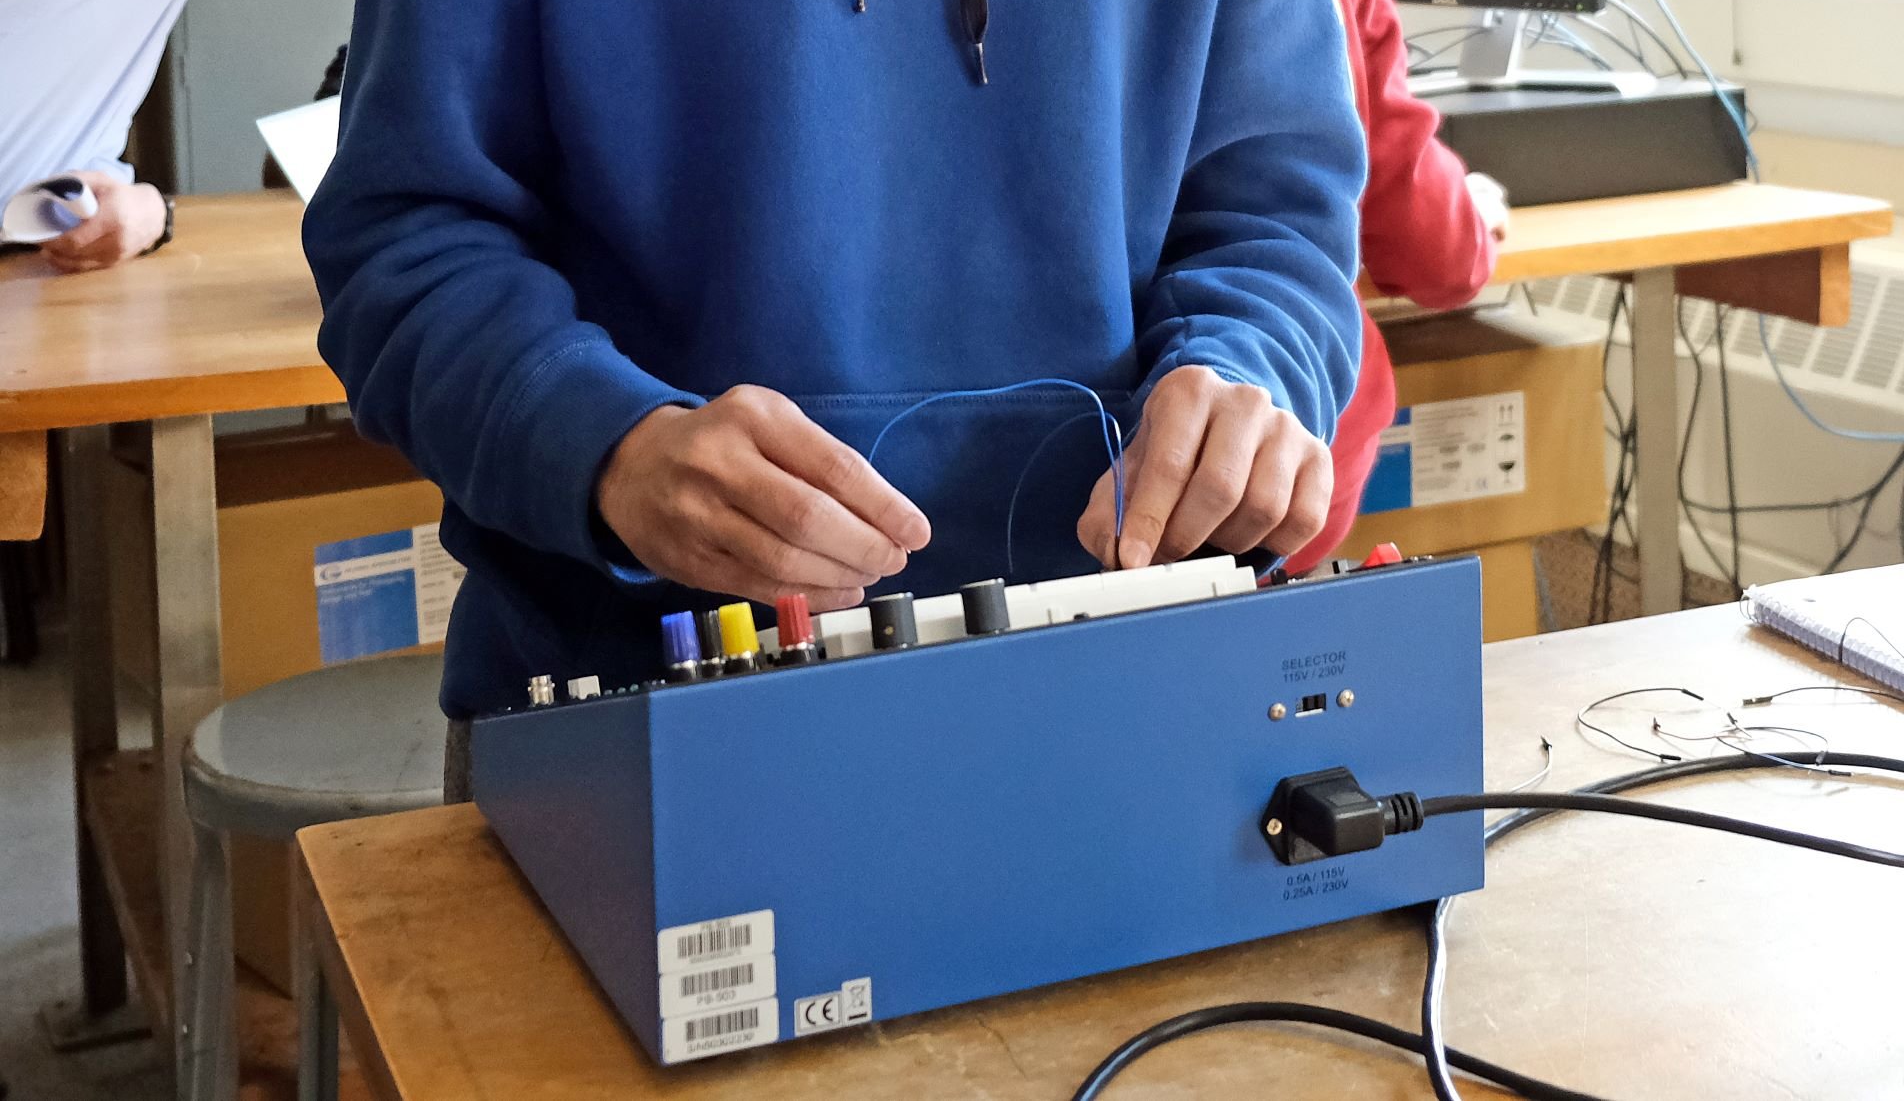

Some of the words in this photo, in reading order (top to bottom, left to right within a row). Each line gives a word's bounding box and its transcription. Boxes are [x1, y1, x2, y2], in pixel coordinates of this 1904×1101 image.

[1282, 651, 1346, 670] SELECTOR
[1284, 671, 1308, 683] 115V
[1318, 664, 1345, 678] 230V
[1322, 878, 1349, 894] 230V
